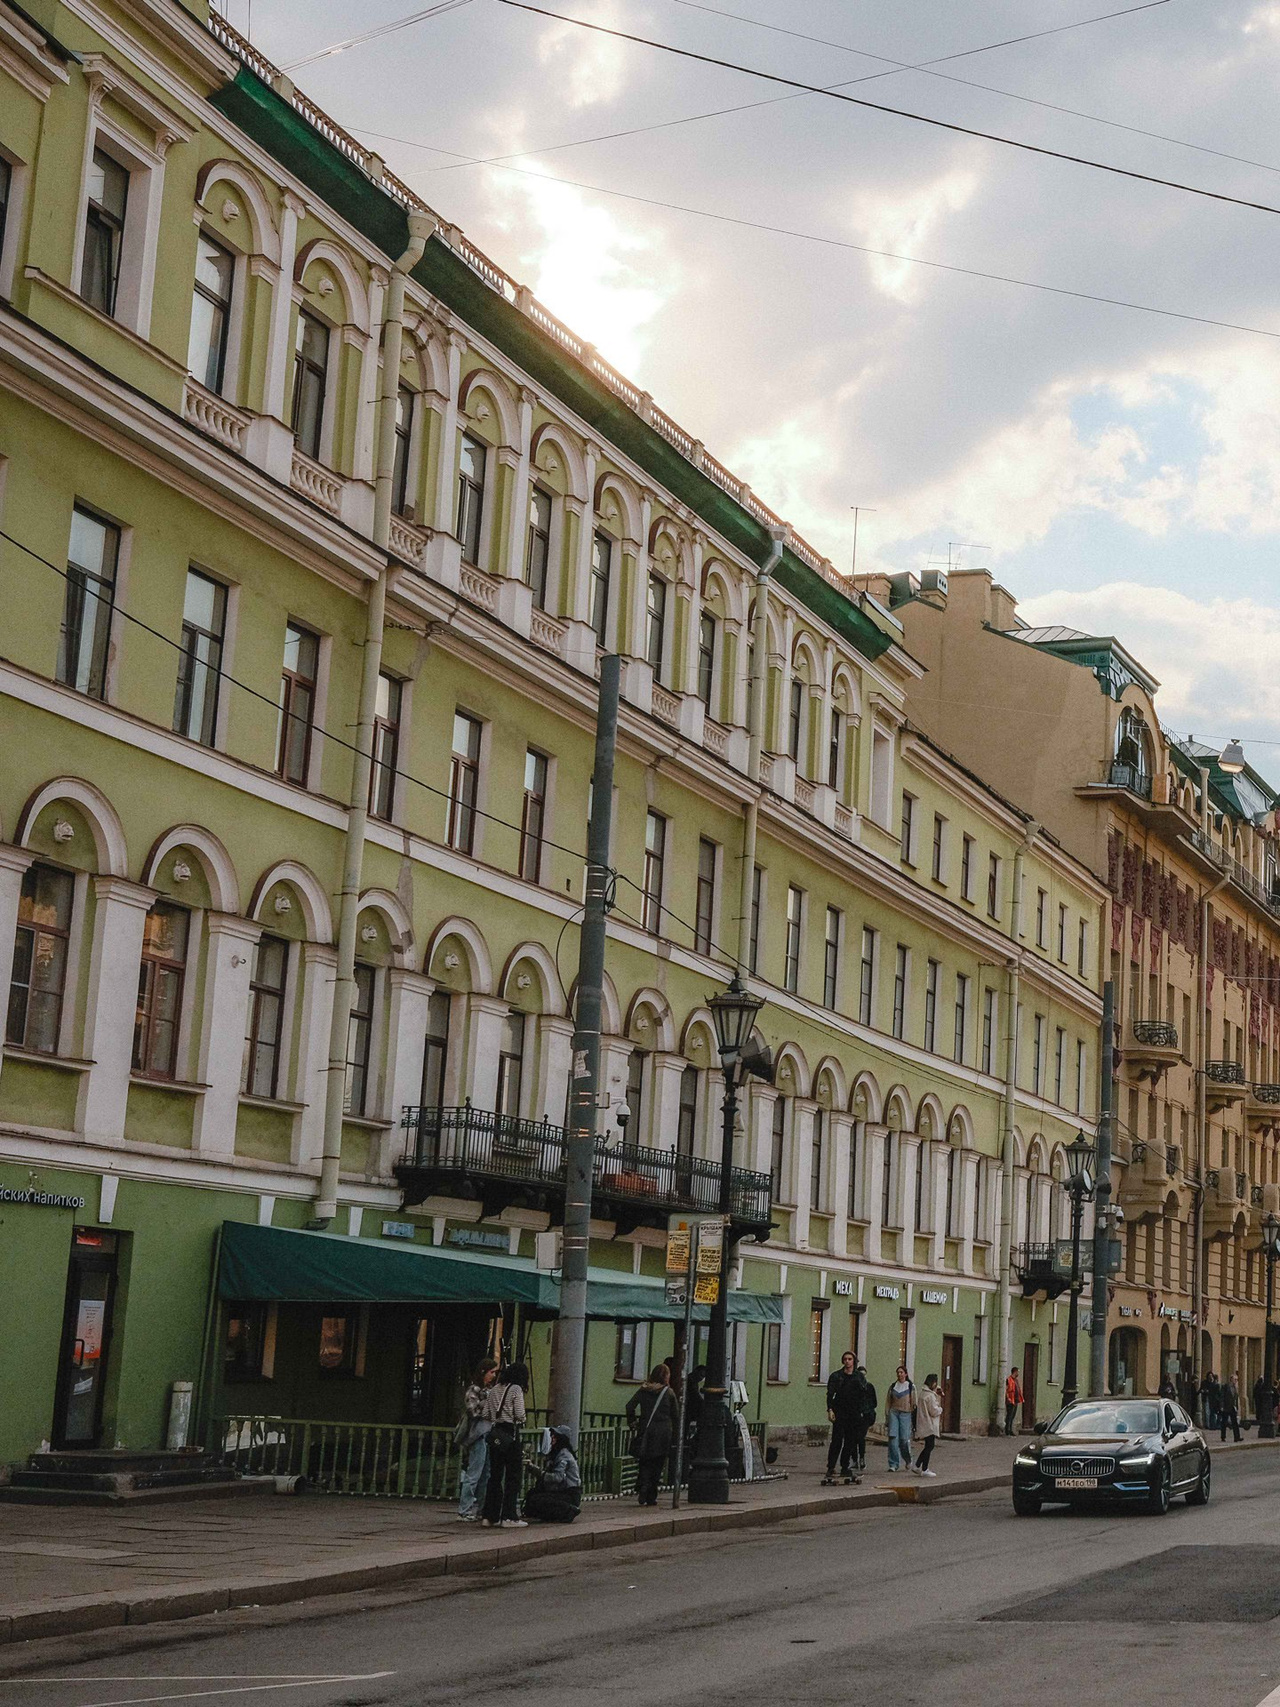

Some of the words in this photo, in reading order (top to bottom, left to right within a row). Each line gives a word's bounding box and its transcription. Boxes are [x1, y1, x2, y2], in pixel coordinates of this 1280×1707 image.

[34, 1192, 85, 1208] напитков
[836, 1280, 853, 1296] МЕХА
[876, 1285, 899, 1300] МЕХГРАД
[922, 1290, 947, 1304] КАШЕМИР
